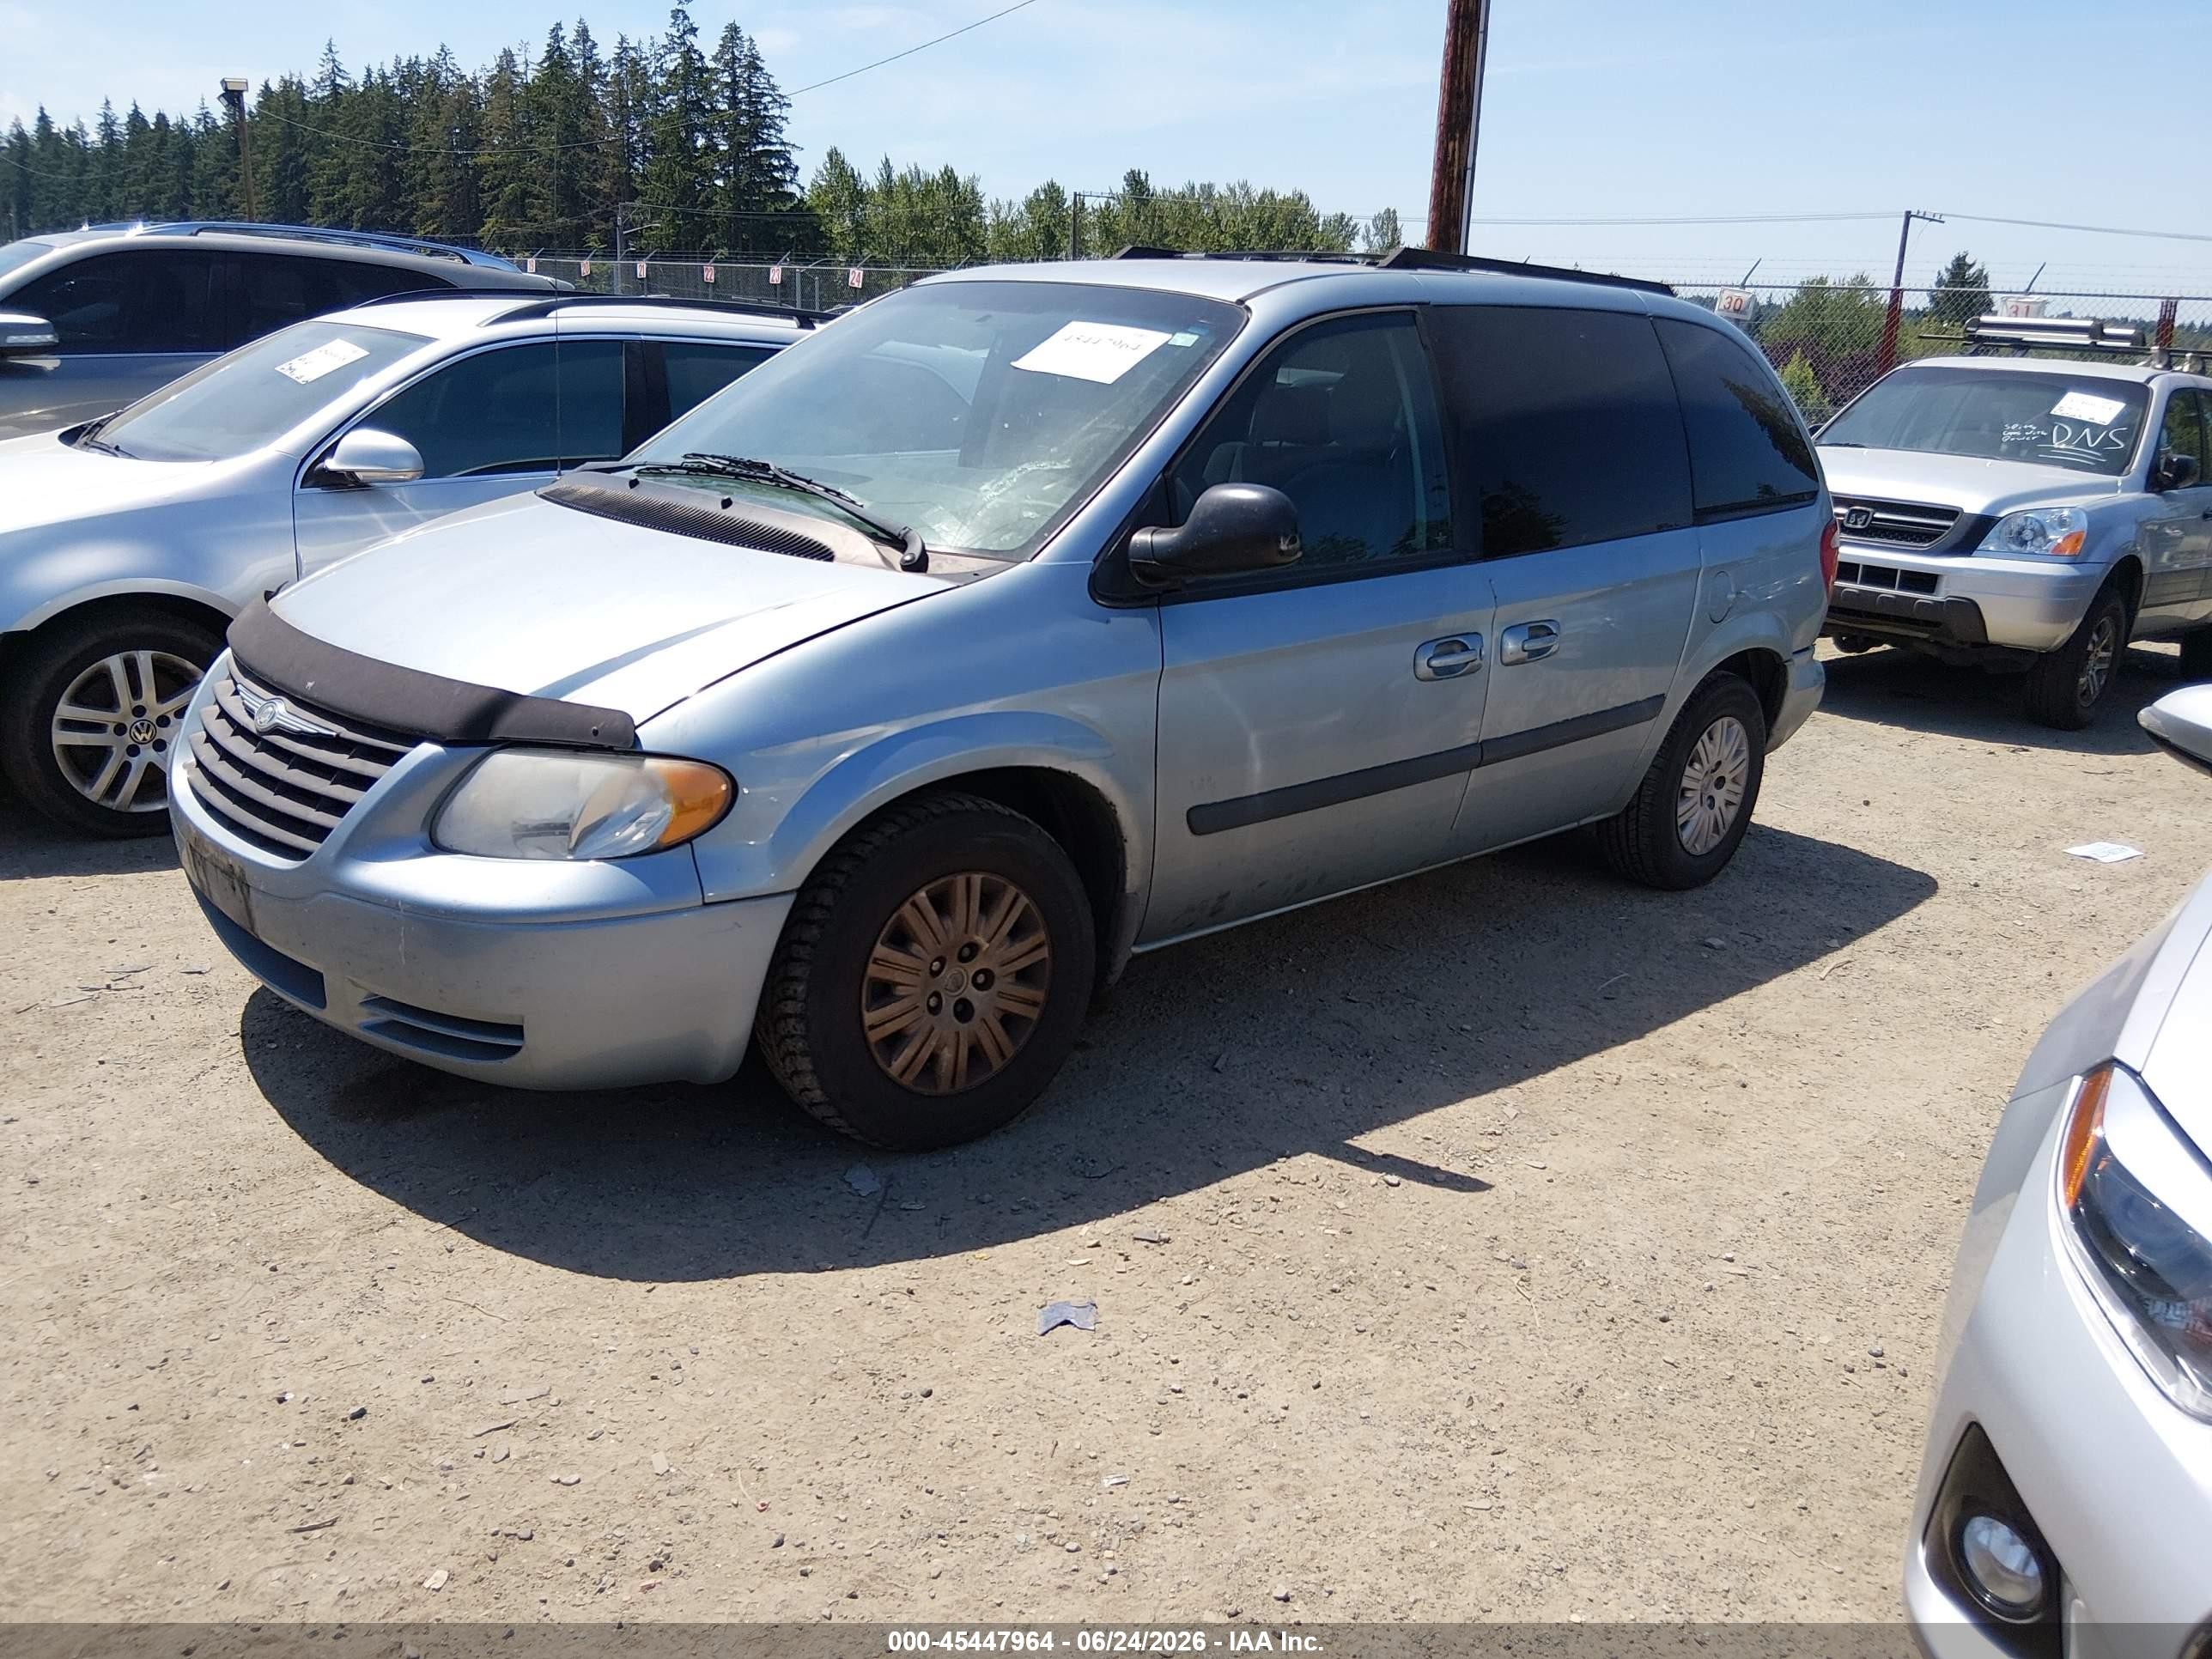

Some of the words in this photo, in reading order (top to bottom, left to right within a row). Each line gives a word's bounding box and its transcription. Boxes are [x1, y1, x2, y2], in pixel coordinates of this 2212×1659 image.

[582, 261, 589, 275] 20
[639, 264, 645, 276] 21
[705, 268, 714, 281] 22
[771, 268, 780, 283] 23
[850, 270, 861, 286] 24
[1723, 294, 1743, 312] 30
[2008, 304, 2030, 317] 31
[2052, 422, 2129, 450] DNS
